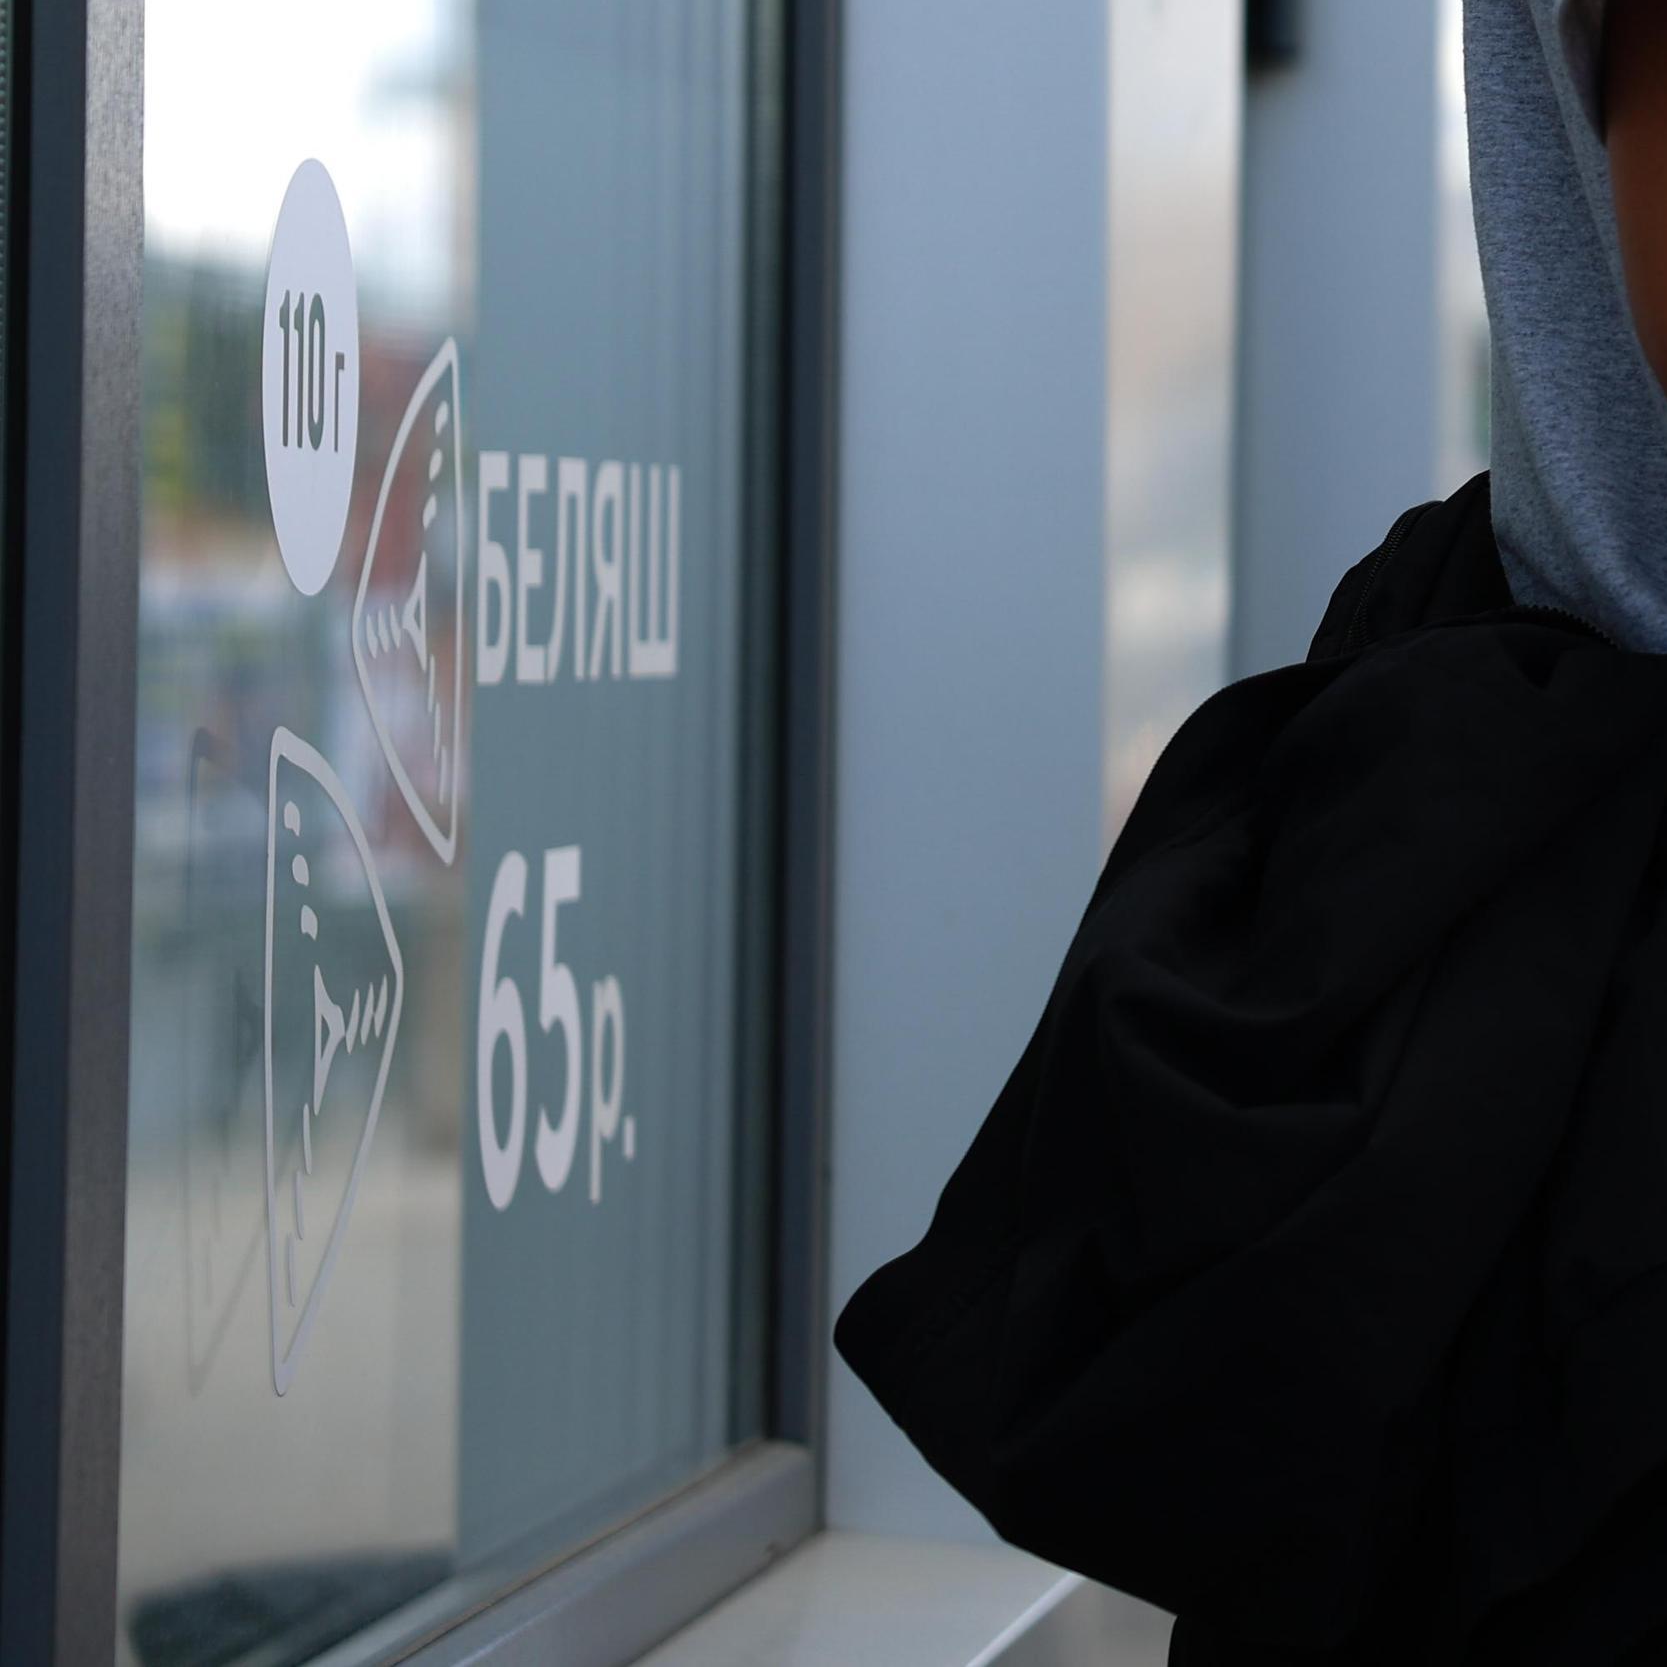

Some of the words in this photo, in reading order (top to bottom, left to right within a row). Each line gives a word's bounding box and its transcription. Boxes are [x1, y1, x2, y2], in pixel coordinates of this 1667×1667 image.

[279, 289, 326, 452] 110
[333, 351, 345, 454] г
[476, 449, 680, 687] БЕЛЯШ
